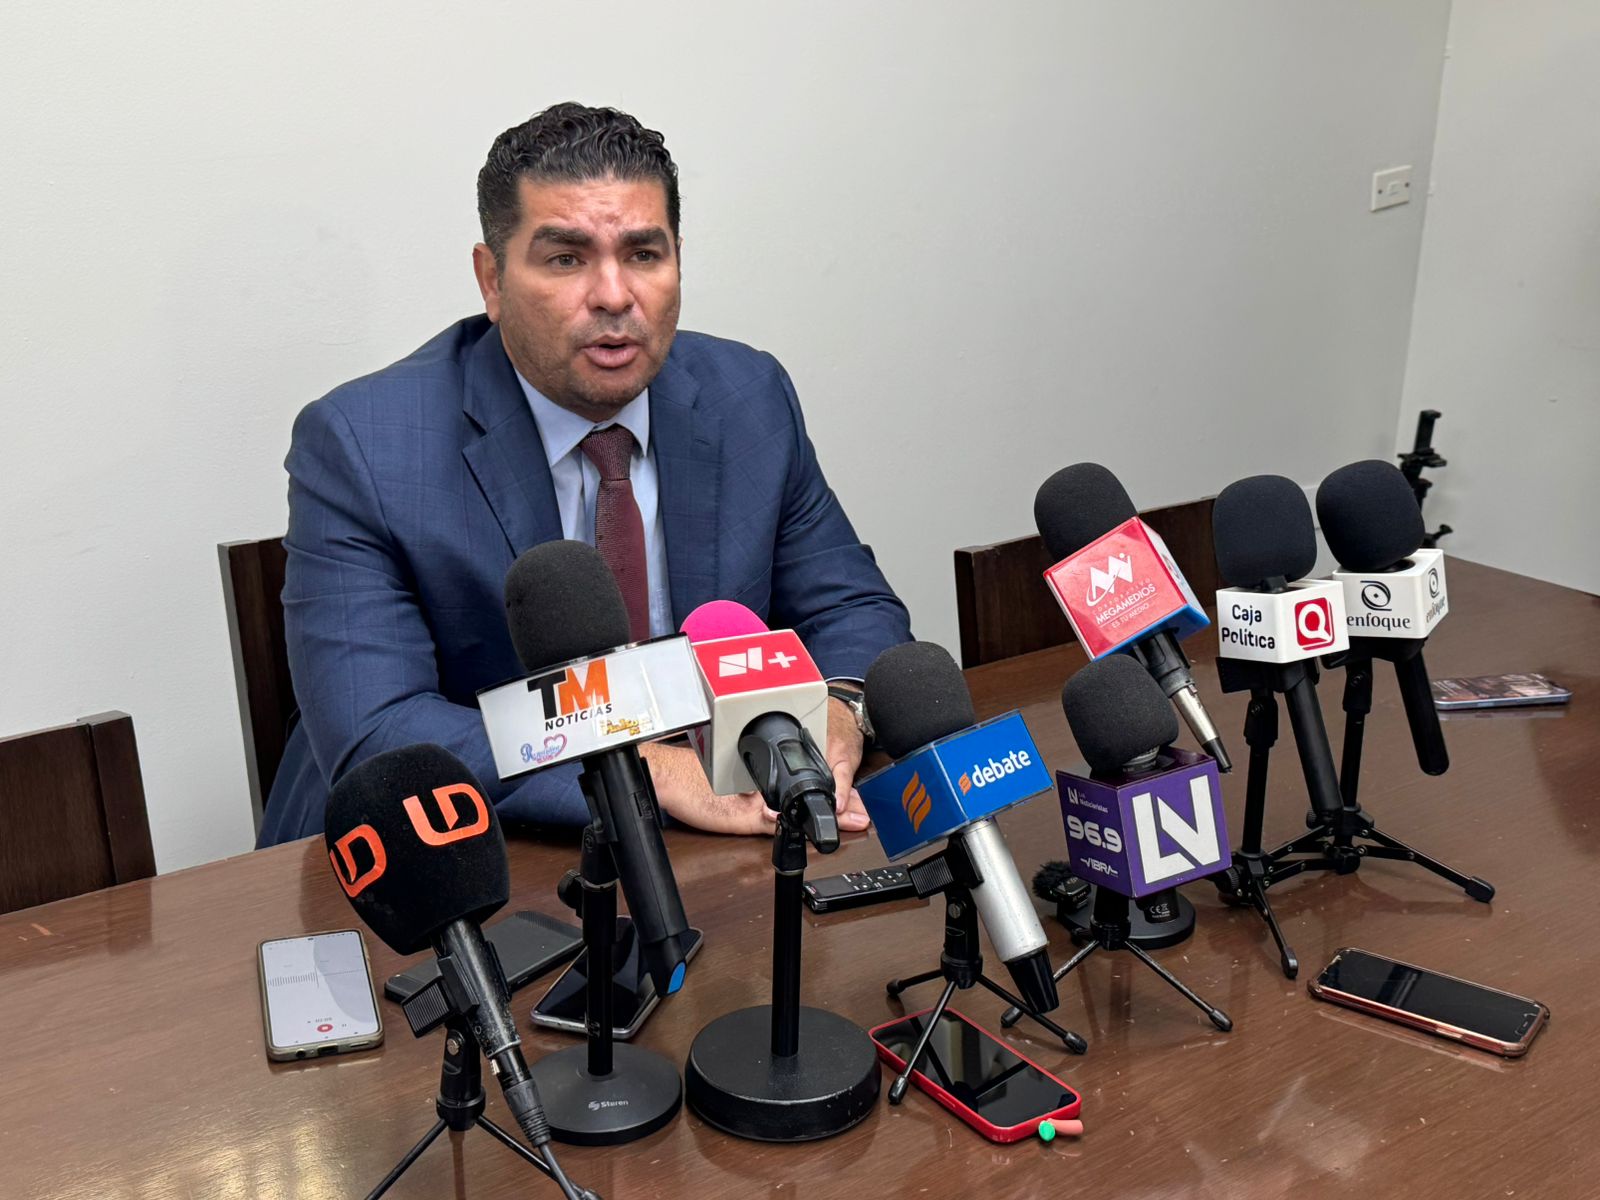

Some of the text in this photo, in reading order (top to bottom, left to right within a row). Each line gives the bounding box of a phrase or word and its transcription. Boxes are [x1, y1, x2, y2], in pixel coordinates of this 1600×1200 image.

[1095, 583, 1156, 625] MEGAMEDIOS
[1129, 603, 1150, 619] MEDIO
[1232, 604, 1262, 626] Caja
[1346, 612, 1412, 631] enfoque
[527, 658, 610, 720] TM
[545, 703, 613, 731] NOTICIAS
[972, 750, 1031, 788] debate
[1067, 815, 1122, 853] 96.9
